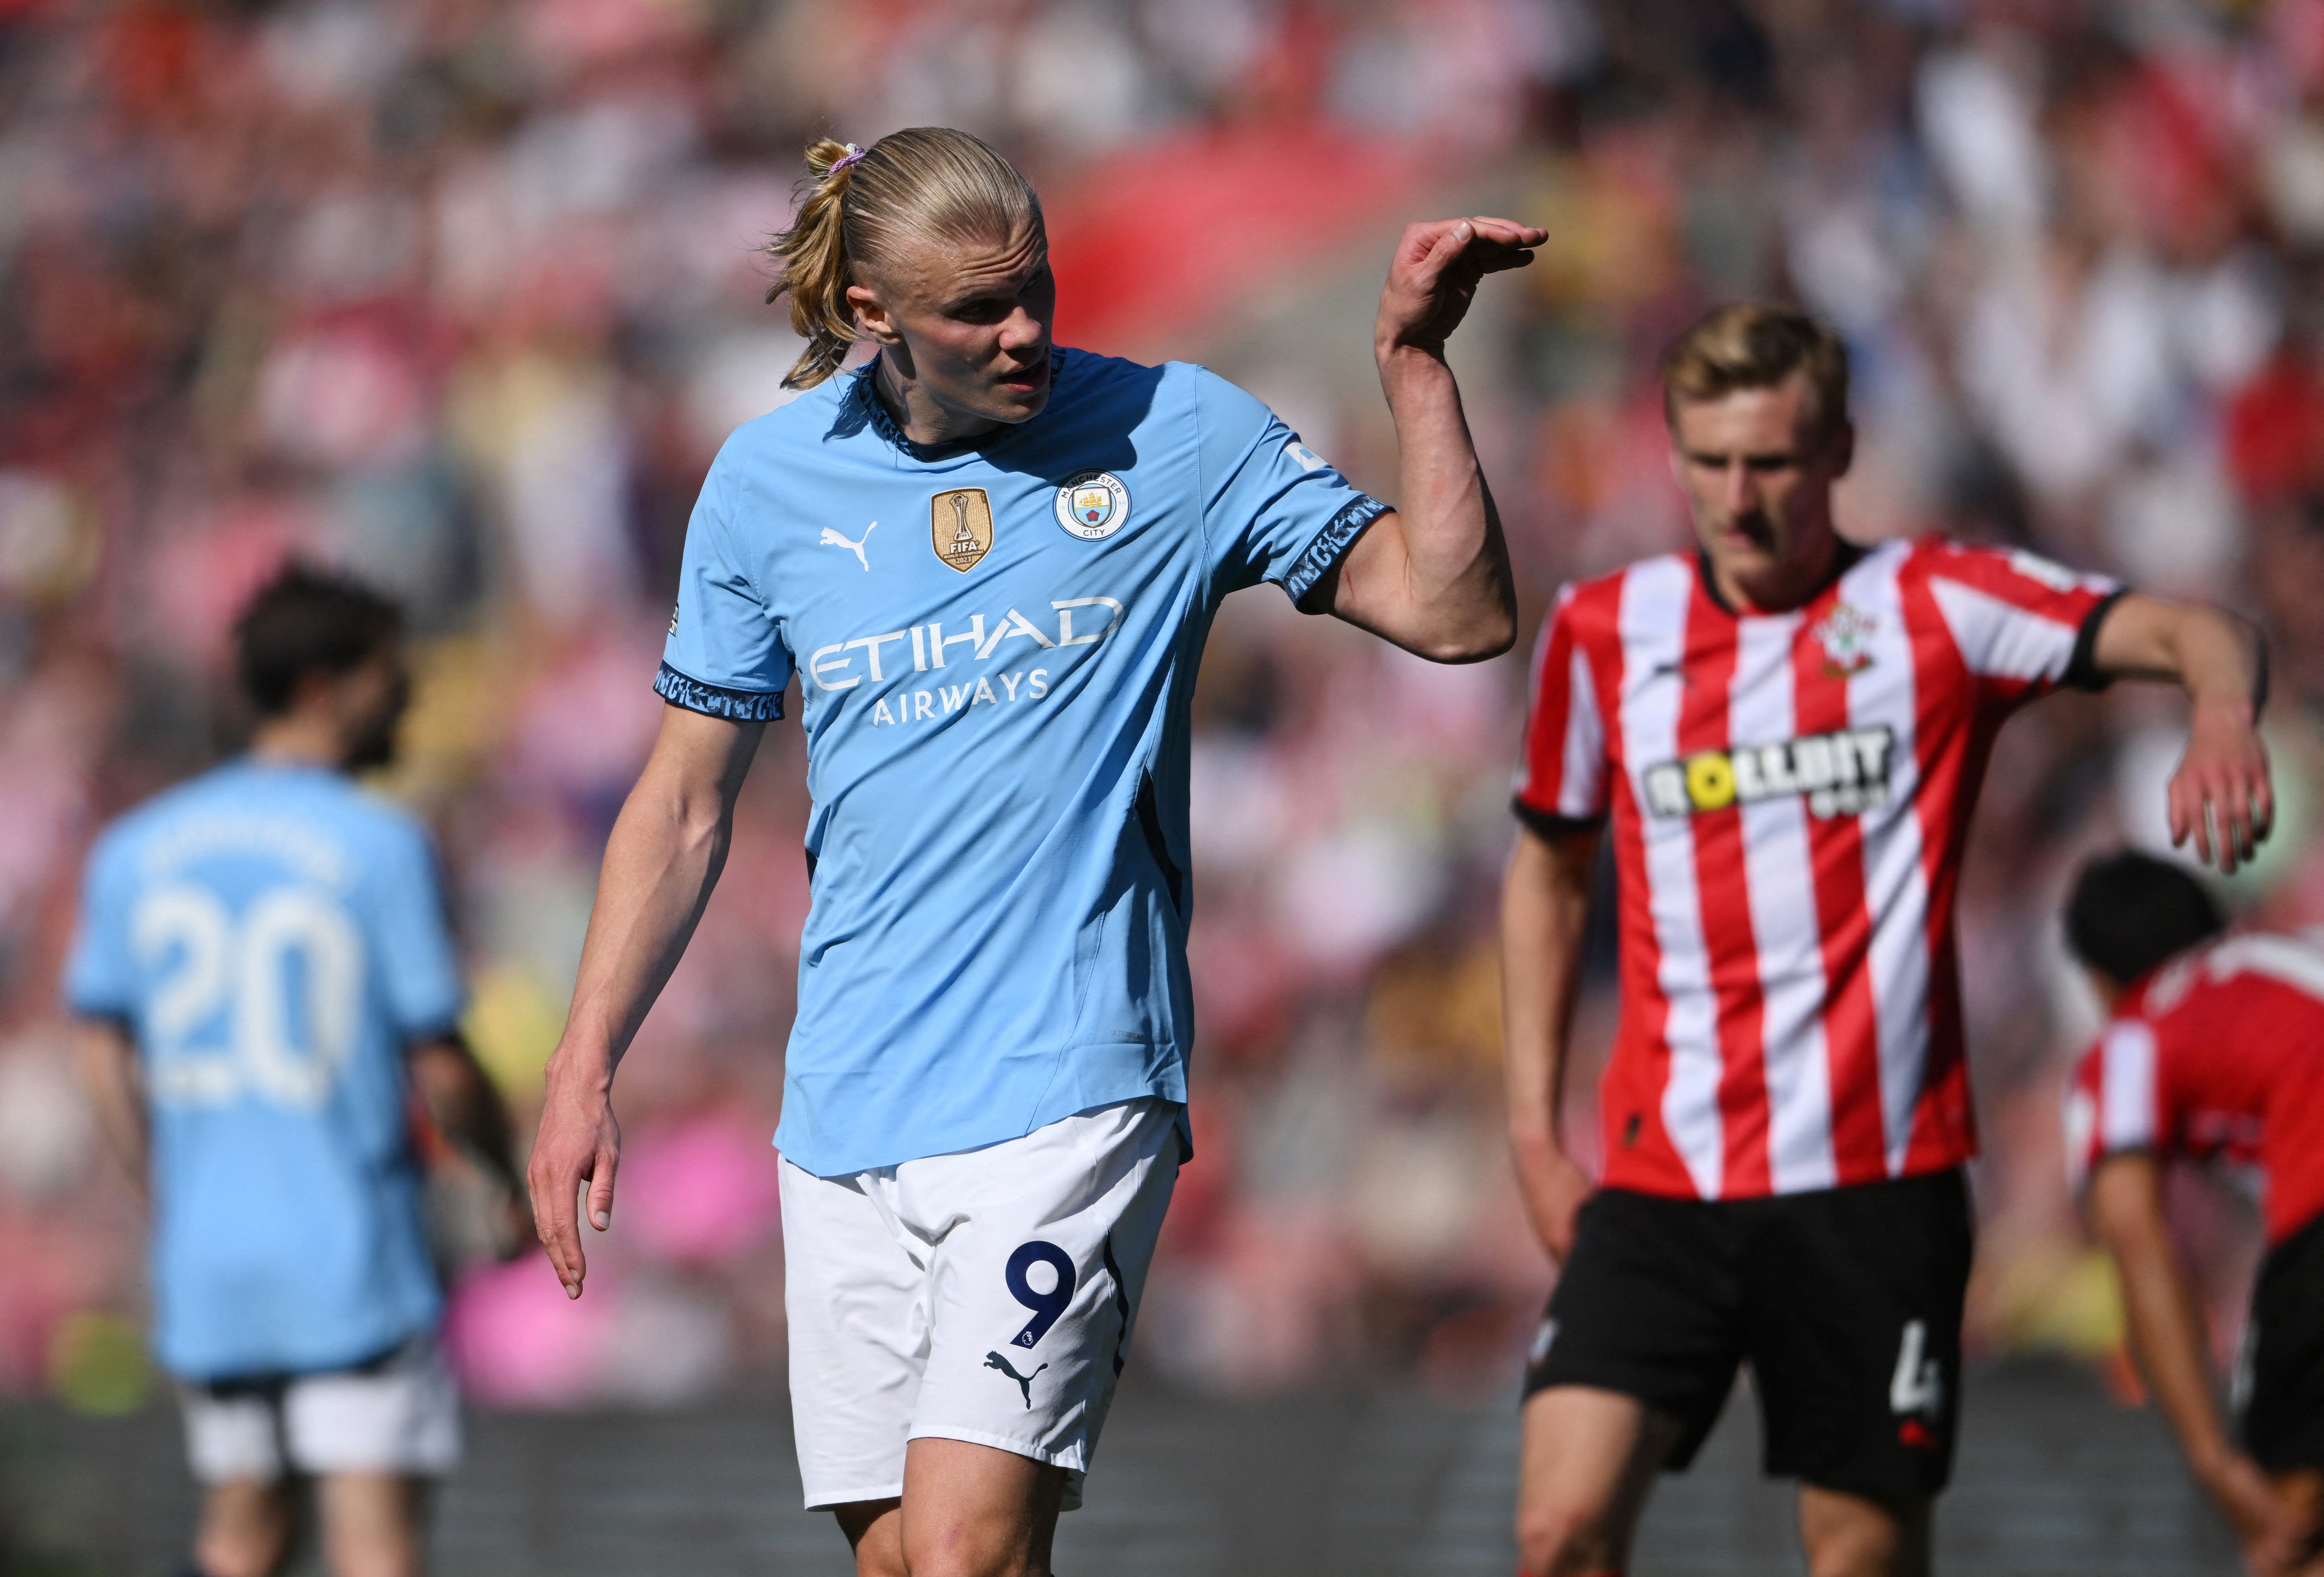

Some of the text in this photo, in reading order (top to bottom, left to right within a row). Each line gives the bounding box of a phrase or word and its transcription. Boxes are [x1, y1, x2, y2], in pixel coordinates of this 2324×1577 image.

[1061, 474, 1122, 498] MANCHESTER
[950, 541, 977, 553] FIFA
[810, 596, 1124, 691] ETIHAD
[873, 669, 1048, 727] AIRWAYS
[133, 885, 364, 1105] 20
[1005, 1240, 1077, 1350] 9
[1889, 1319, 1941, 1421] 4
